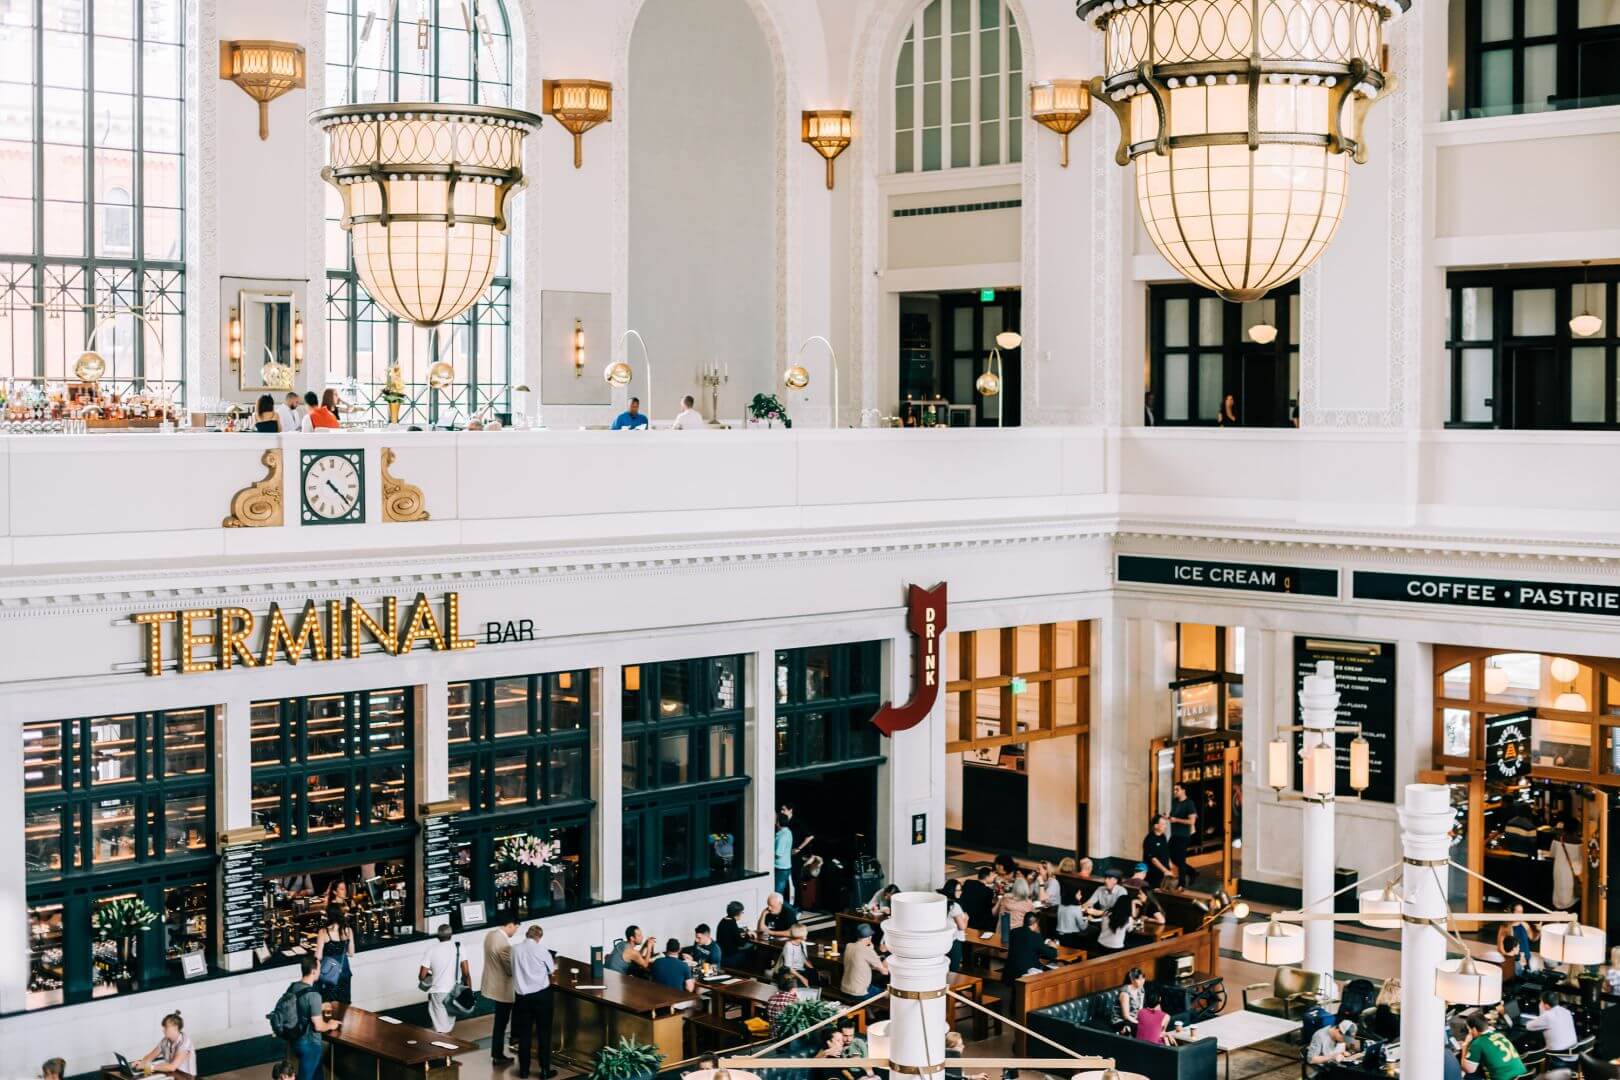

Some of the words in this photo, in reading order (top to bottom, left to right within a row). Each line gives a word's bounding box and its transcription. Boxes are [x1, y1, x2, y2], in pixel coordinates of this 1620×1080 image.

[1174, 565, 1204, 581] ICE
[1209, 567, 1276, 586] CREAM
[1407, 581, 1496, 601] COFFEE
[130, 591, 477, 676] TERMINAL
[486, 619, 535, 645] BAR
[925, 607, 936, 686] DRINK
